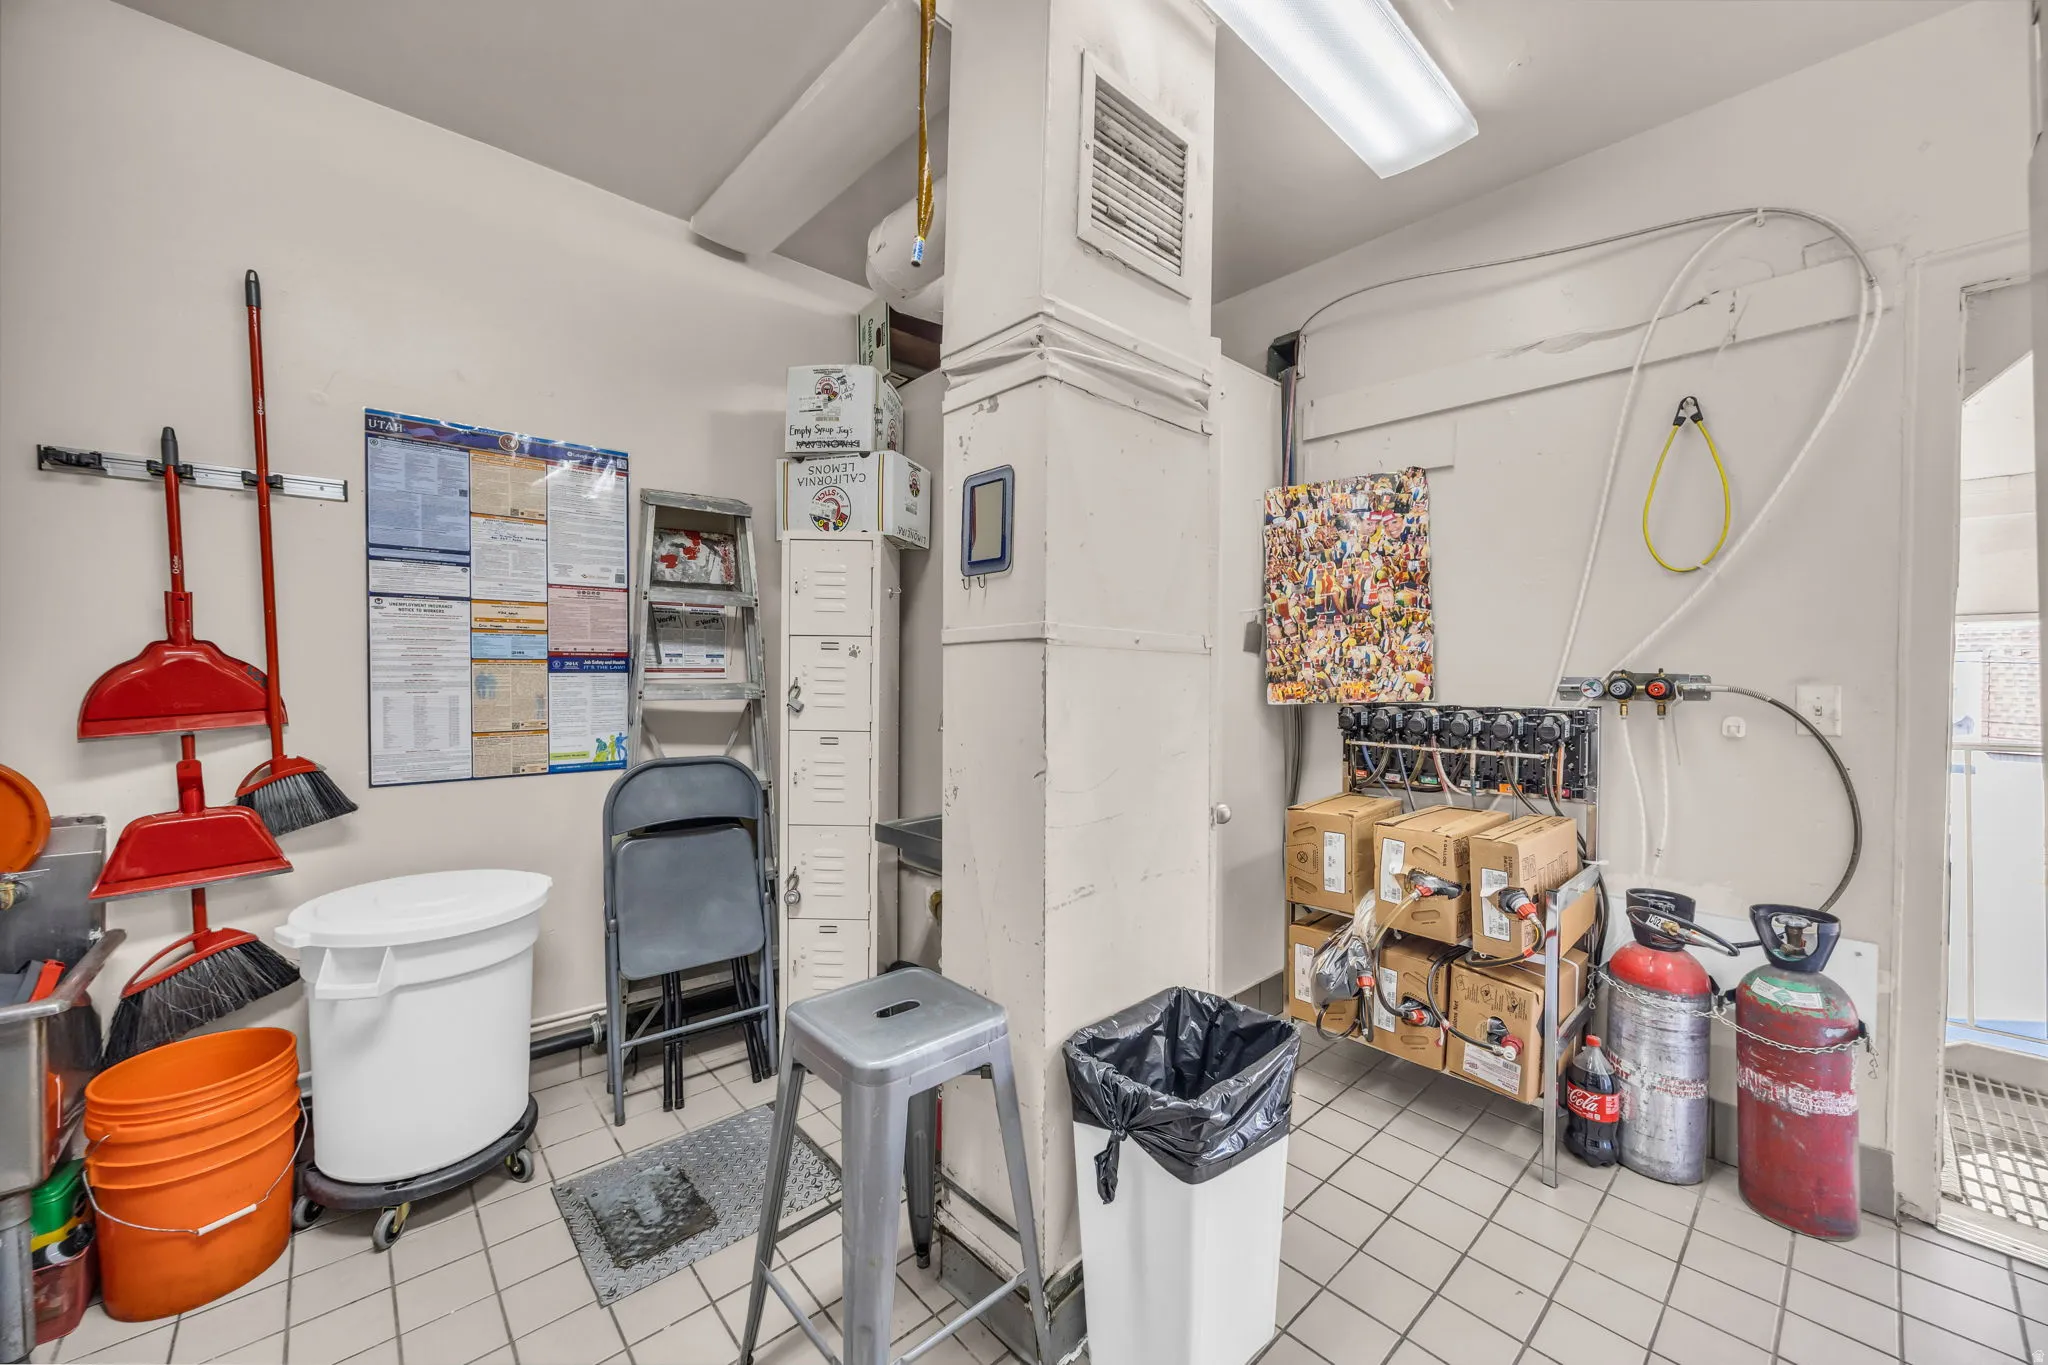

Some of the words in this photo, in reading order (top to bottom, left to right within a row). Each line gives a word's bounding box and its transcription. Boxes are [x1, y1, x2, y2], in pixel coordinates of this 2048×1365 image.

[368, 418, 403, 432] UTAH
[789, 424, 811, 438] Empty
[814, 424, 834, 435] Syrup
[808, 463, 854, 475] LEMONS
[797, 473, 866, 486] CALIFORNIA
[815, 489, 837, 502] STICK
[1569, 1089, 1601, 1112] Cola
